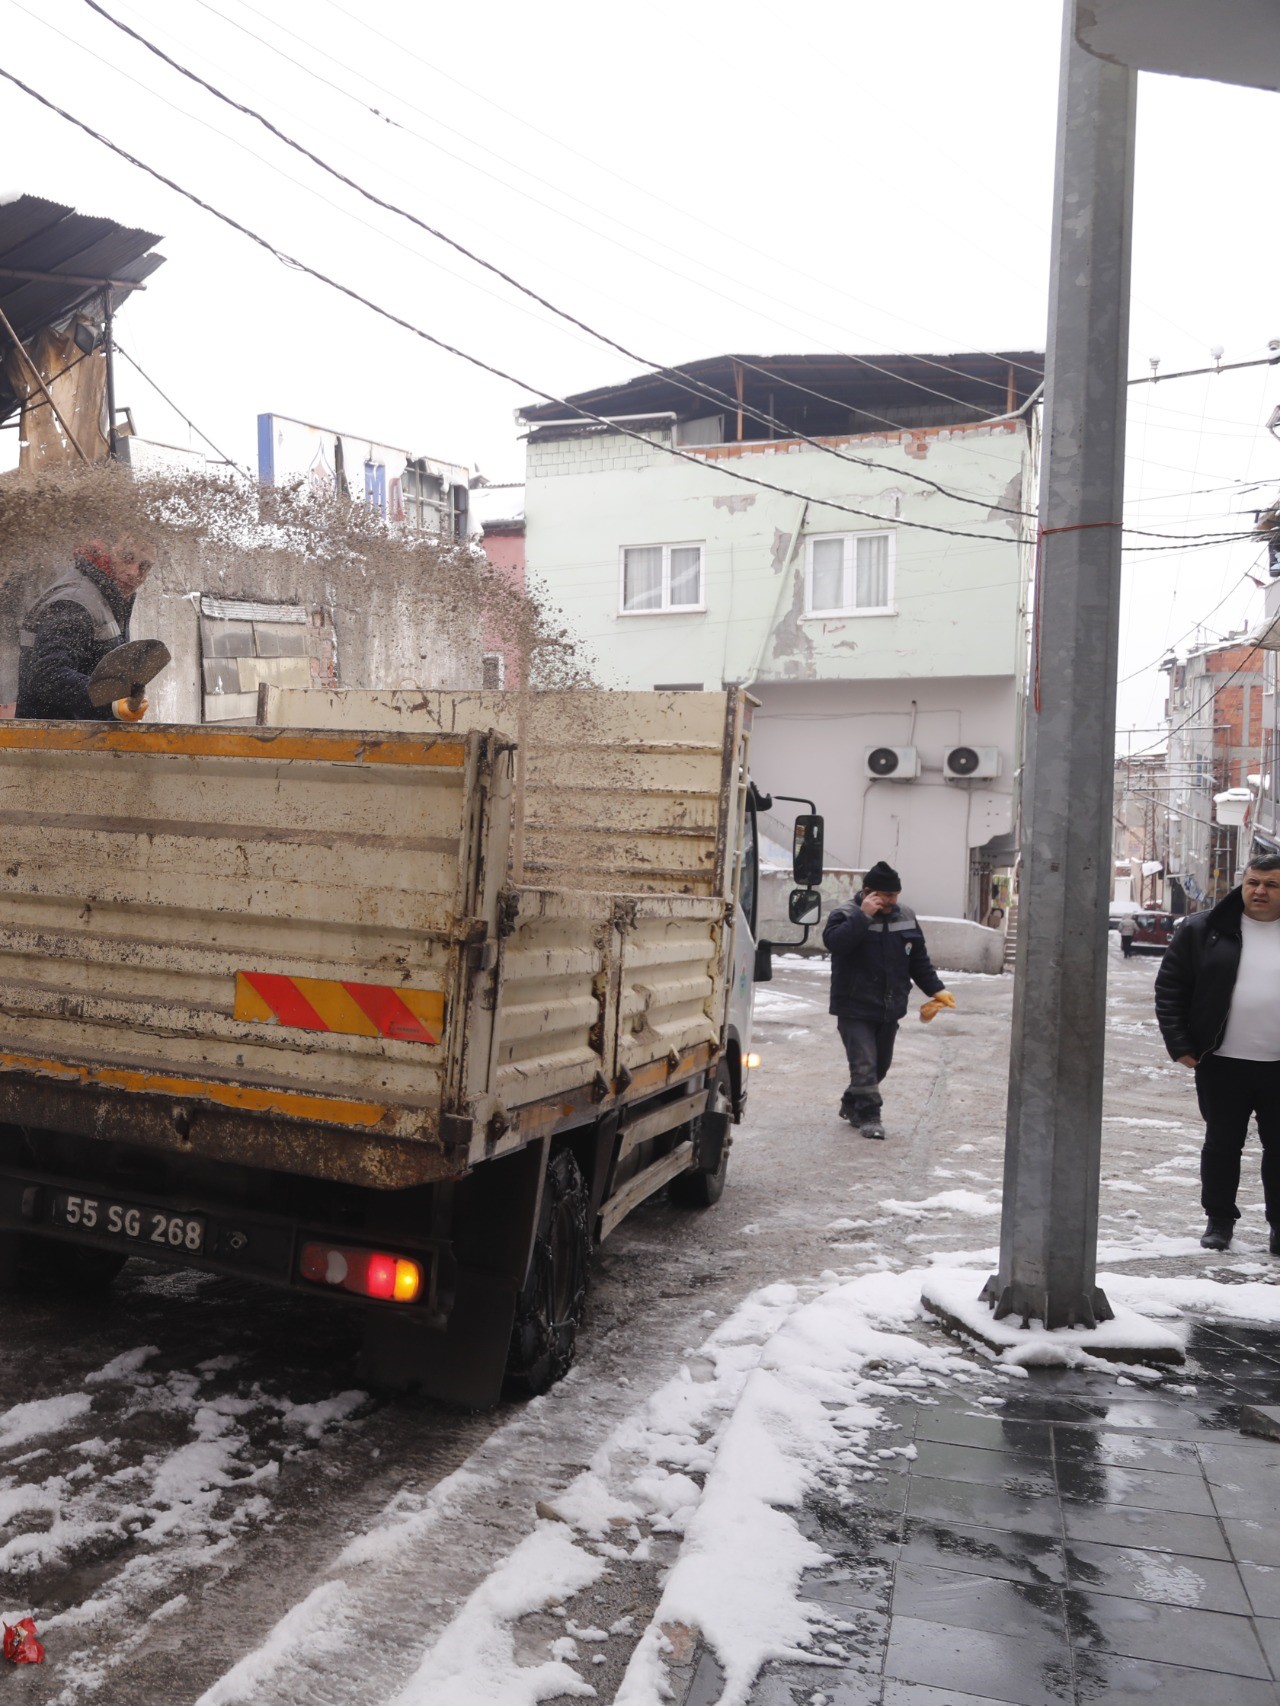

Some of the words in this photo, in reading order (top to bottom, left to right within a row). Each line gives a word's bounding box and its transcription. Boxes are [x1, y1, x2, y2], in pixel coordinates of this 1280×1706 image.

[66, 1196, 98, 1227] 55
[107, 1205, 141, 1237] SG
[150, 1214, 201, 1250] 268
